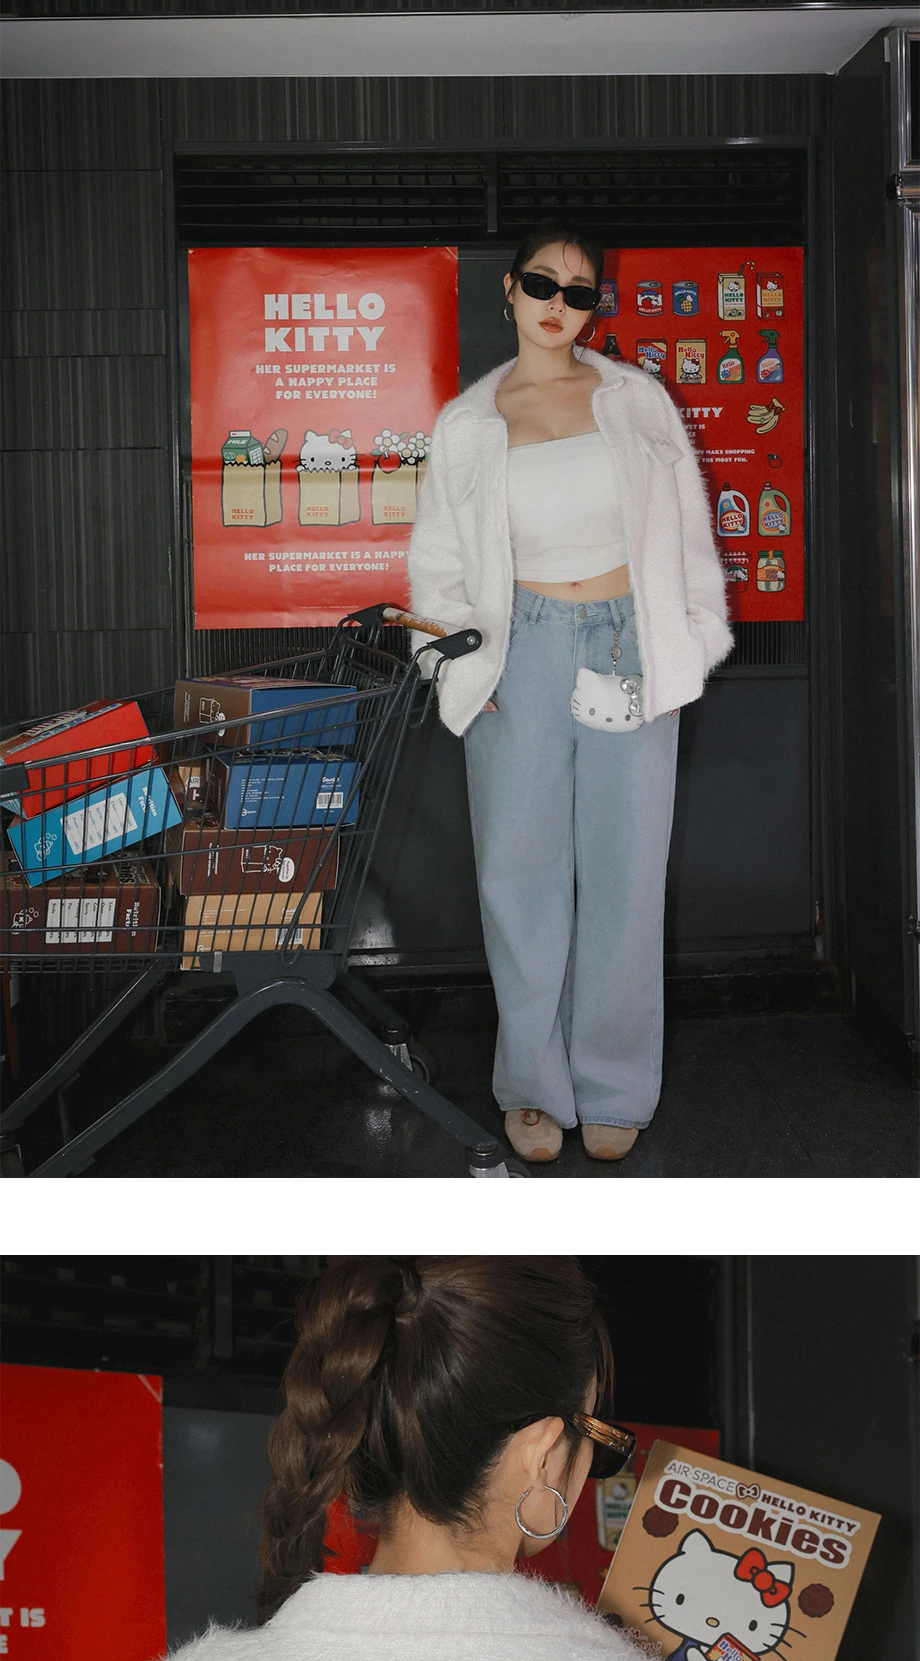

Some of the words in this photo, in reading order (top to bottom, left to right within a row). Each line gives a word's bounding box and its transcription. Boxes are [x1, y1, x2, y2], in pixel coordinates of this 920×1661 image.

[264, 293, 386, 320] HELLO
[265, 326, 385, 352] KITTY
[256, 365, 280, 374] HER
[285, 364, 380, 374] SUPERMARKET
[384, 363, 396, 373] IS
[275, 378, 285, 387] A
[288, 377, 334, 387] HAPPY
[338, 377, 378, 387] PLACE
[276, 390, 302, 400] FOR
[306, 389, 378, 399] EVERYONE!
[244, 552, 265, 561] HER
[268, 551, 348, 560] SUPERMARKET
[350, 551, 362, 559] IS
[364, 551, 373, 559] A
[269, 563, 303, 572] PLACE
[305, 563, 327, 572] FOR
[330, 562, 390, 571] EVERYONE!
[667, 1462, 690, 1478] AIR
[692, 1469, 736, 1493] SPACE
[761, 1493, 806, 1517] HELLO
[809, 1509, 857, 1533] KITTY
[659, 1478, 849, 1565] Cookies
[20, 1608, 46, 1629] IS
